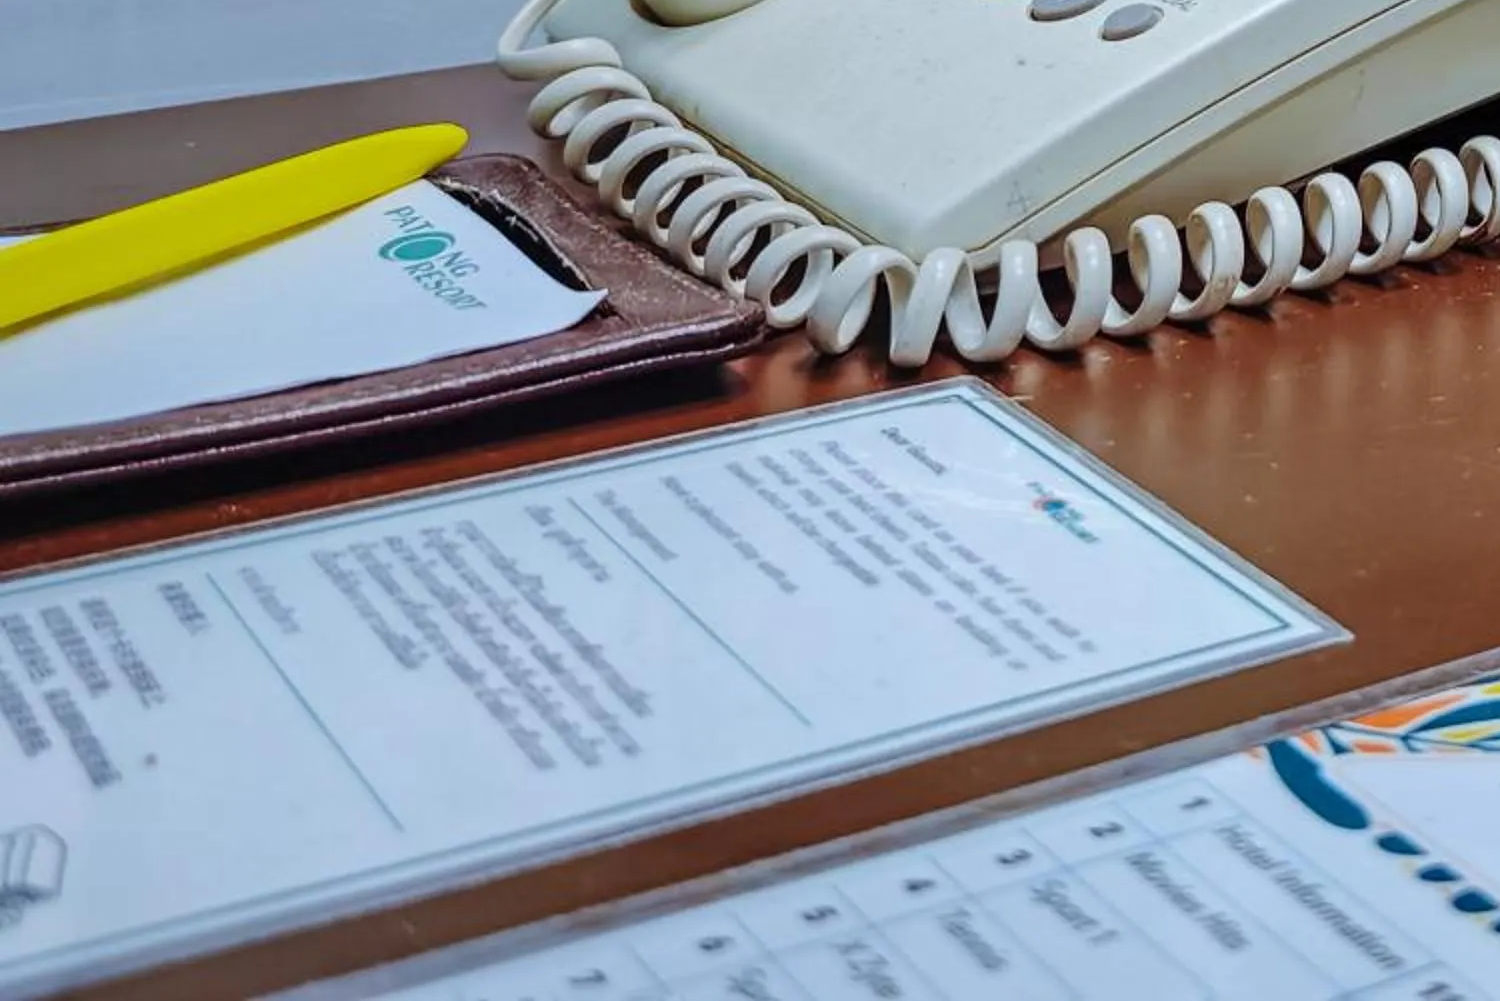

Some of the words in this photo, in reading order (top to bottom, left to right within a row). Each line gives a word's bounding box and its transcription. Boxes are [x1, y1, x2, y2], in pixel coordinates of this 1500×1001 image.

[402, 260, 490, 312] RESORT
[1088, 821, 1126, 838] 2
[1179, 795, 1212, 811] 1
[1212, 822, 1289, 871] Hotel
[996, 848, 1034, 865] 3
[1030, 879, 1100, 931] Sport
